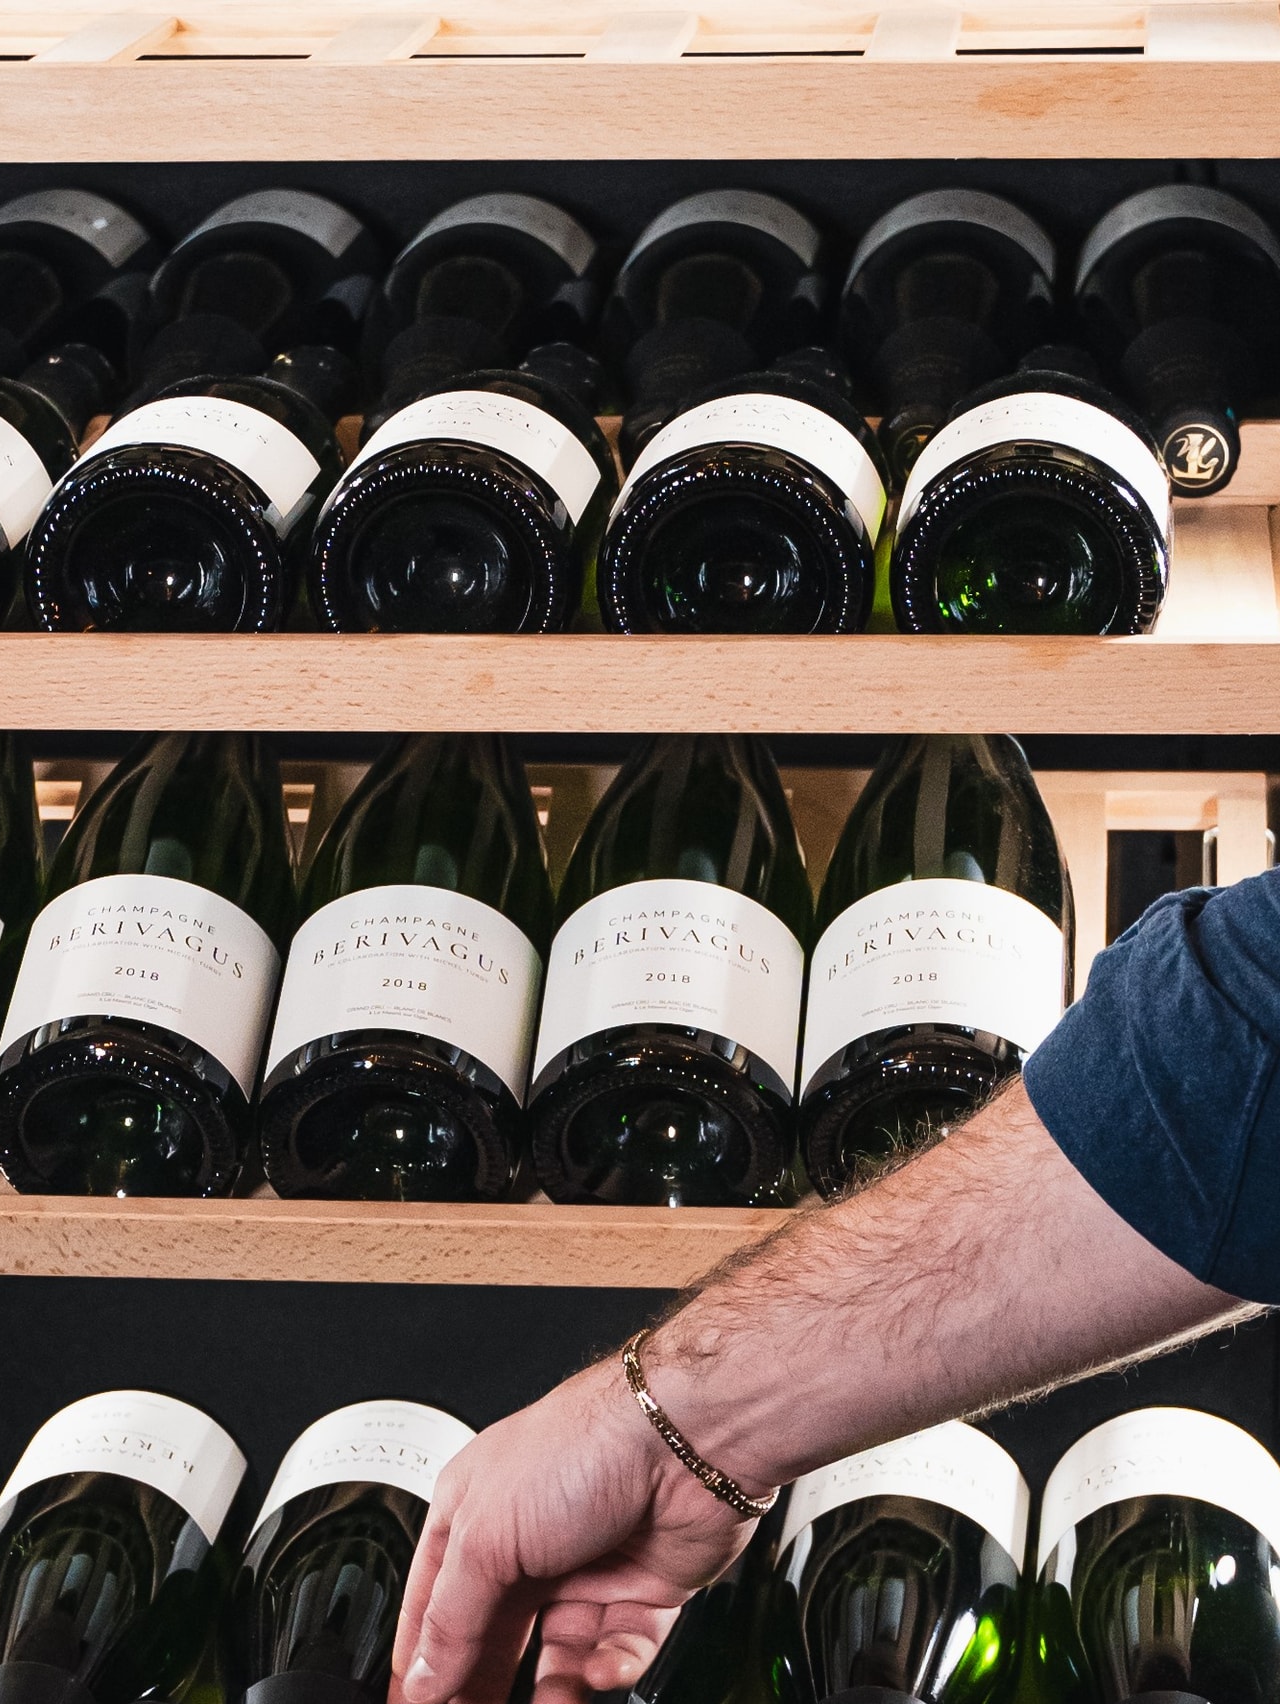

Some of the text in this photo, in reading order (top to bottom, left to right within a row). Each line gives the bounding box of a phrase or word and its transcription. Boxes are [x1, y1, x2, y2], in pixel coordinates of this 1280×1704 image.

[87, 904, 217, 936] CHAMPAGNE
[350, 915, 480, 942] CHAMPAGNE
[608, 910, 739, 933] CHAMPAGNE
[857, 909, 986, 938] CHAMPAGNE
[49, 920, 245, 980] BERIVAGUS
[312, 932, 510, 986] BERIVAGUS
[574, 926, 771, 975] BERIVAGUS
[828, 926, 1023, 982] BERIVAGUS
[114, 966, 161, 981] 2018
[382, 978, 428, 991] 2018
[645, 972, 691, 984] 2018
[892, 972, 939, 985] 2018
